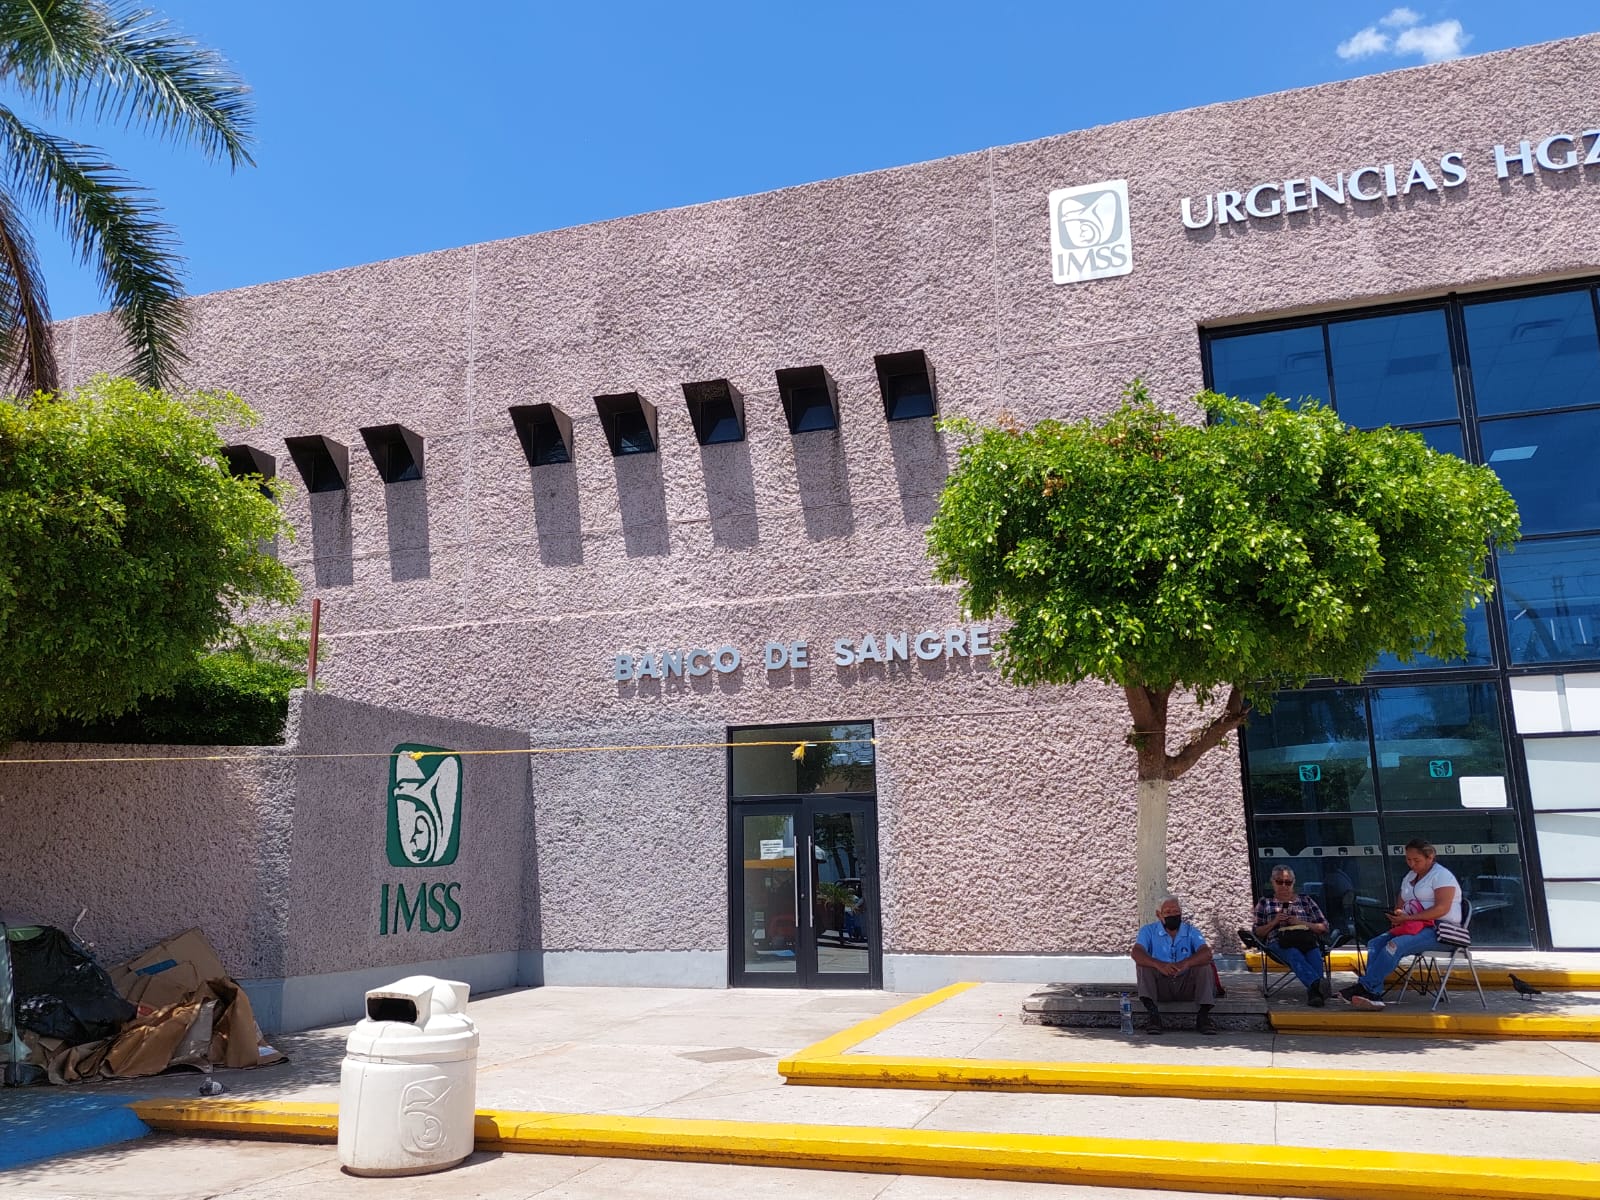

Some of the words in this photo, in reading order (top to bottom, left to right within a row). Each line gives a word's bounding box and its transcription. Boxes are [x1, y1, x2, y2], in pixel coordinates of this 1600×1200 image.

[1180, 152, 1467, 229] URGENCIAS
[1057, 243, 1128, 276] IMSS
[614, 645, 741, 681] BANCO
[764, 641, 809, 670] DE
[834, 626, 991, 667] SANGRE
[380, 882, 461, 935] IMSS
